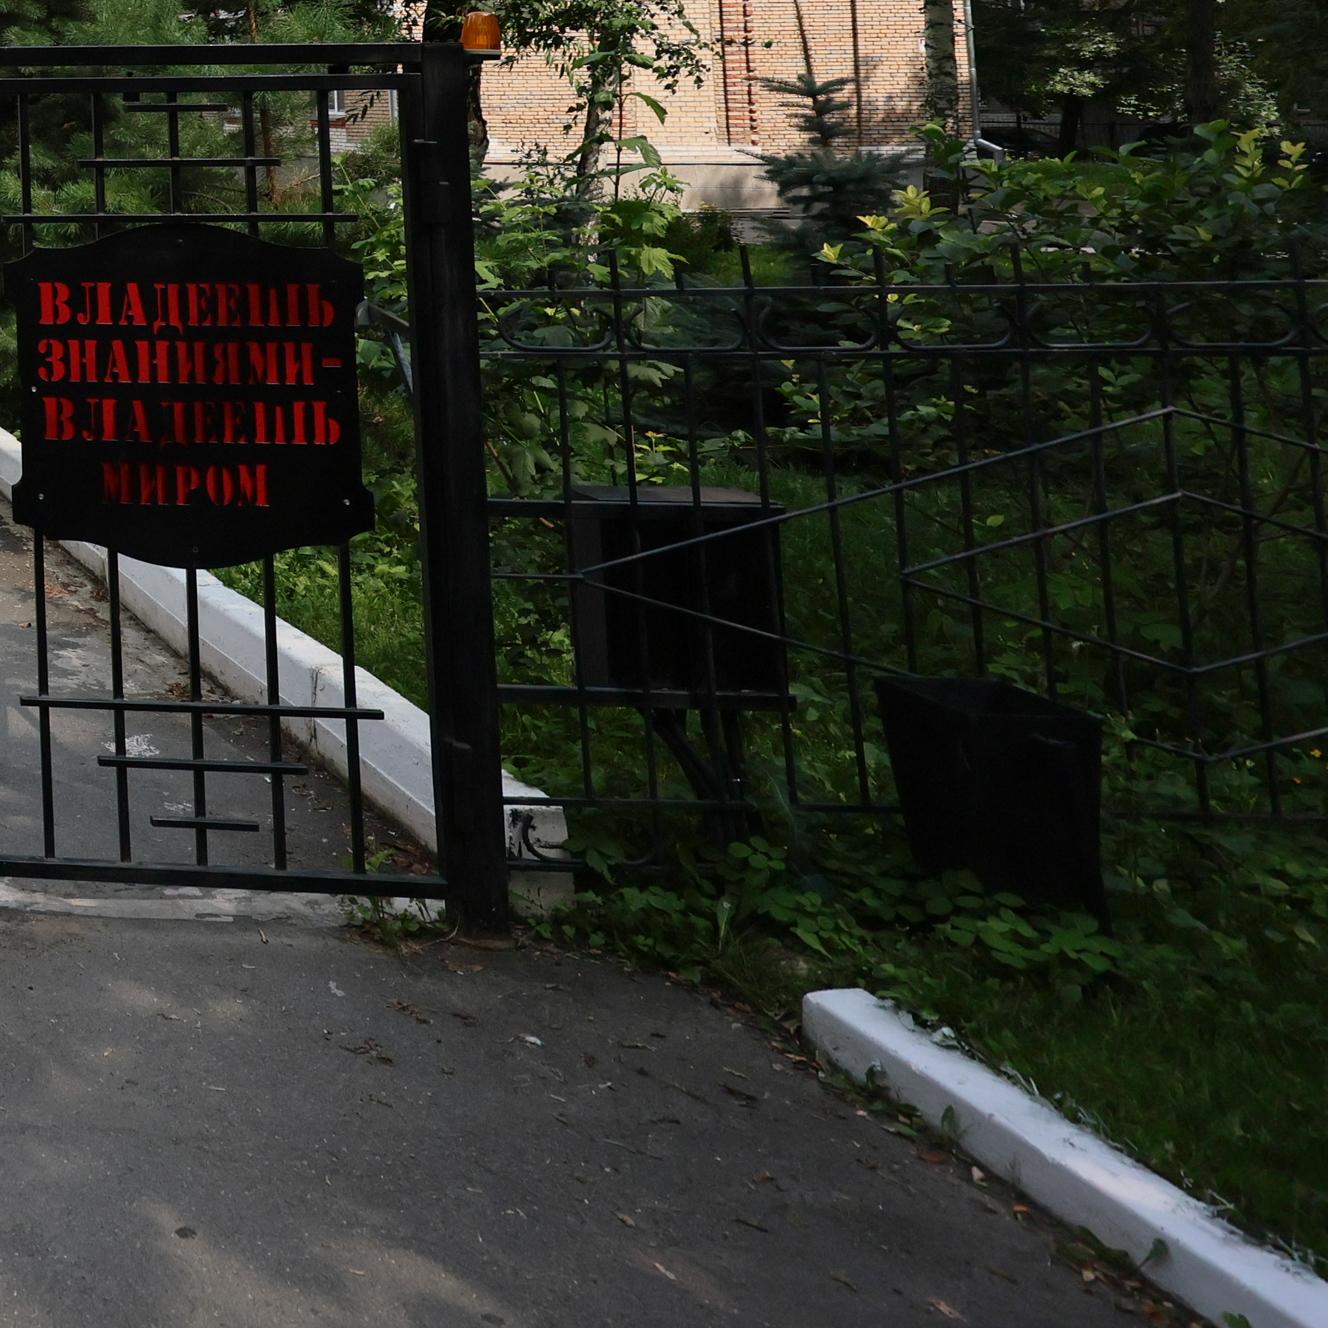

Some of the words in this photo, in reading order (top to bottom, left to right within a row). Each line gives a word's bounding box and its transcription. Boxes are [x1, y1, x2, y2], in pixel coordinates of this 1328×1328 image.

[37, 281, 335, 334] ВЛАДЕЕШЬ
[42, 396, 342, 449] ВЛАДЕЕШЬ
[101, 462, 270, 508] МИРОМ
